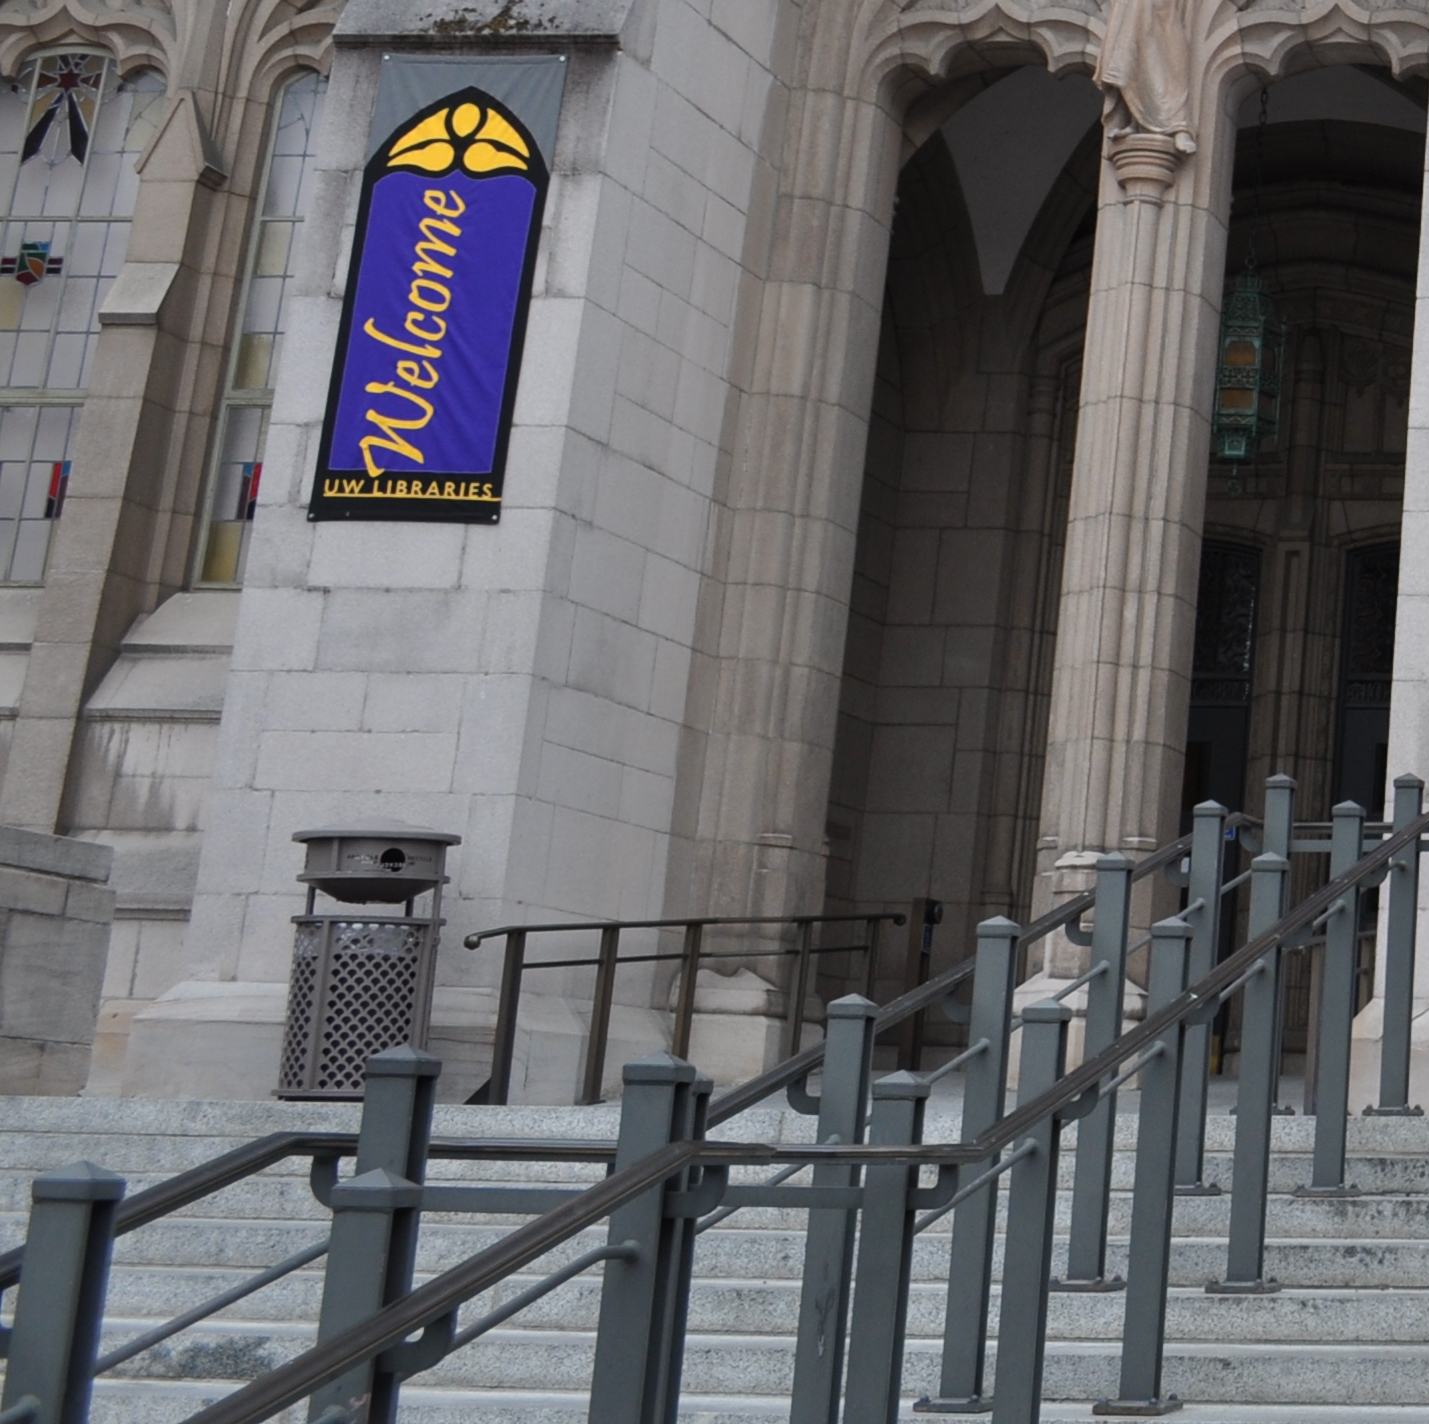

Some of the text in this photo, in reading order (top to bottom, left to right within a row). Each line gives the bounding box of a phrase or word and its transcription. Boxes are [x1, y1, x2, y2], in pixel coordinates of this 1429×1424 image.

[359, 189, 465, 478] Welcome
[323, 478, 494, 499] UW LIBRARIES
